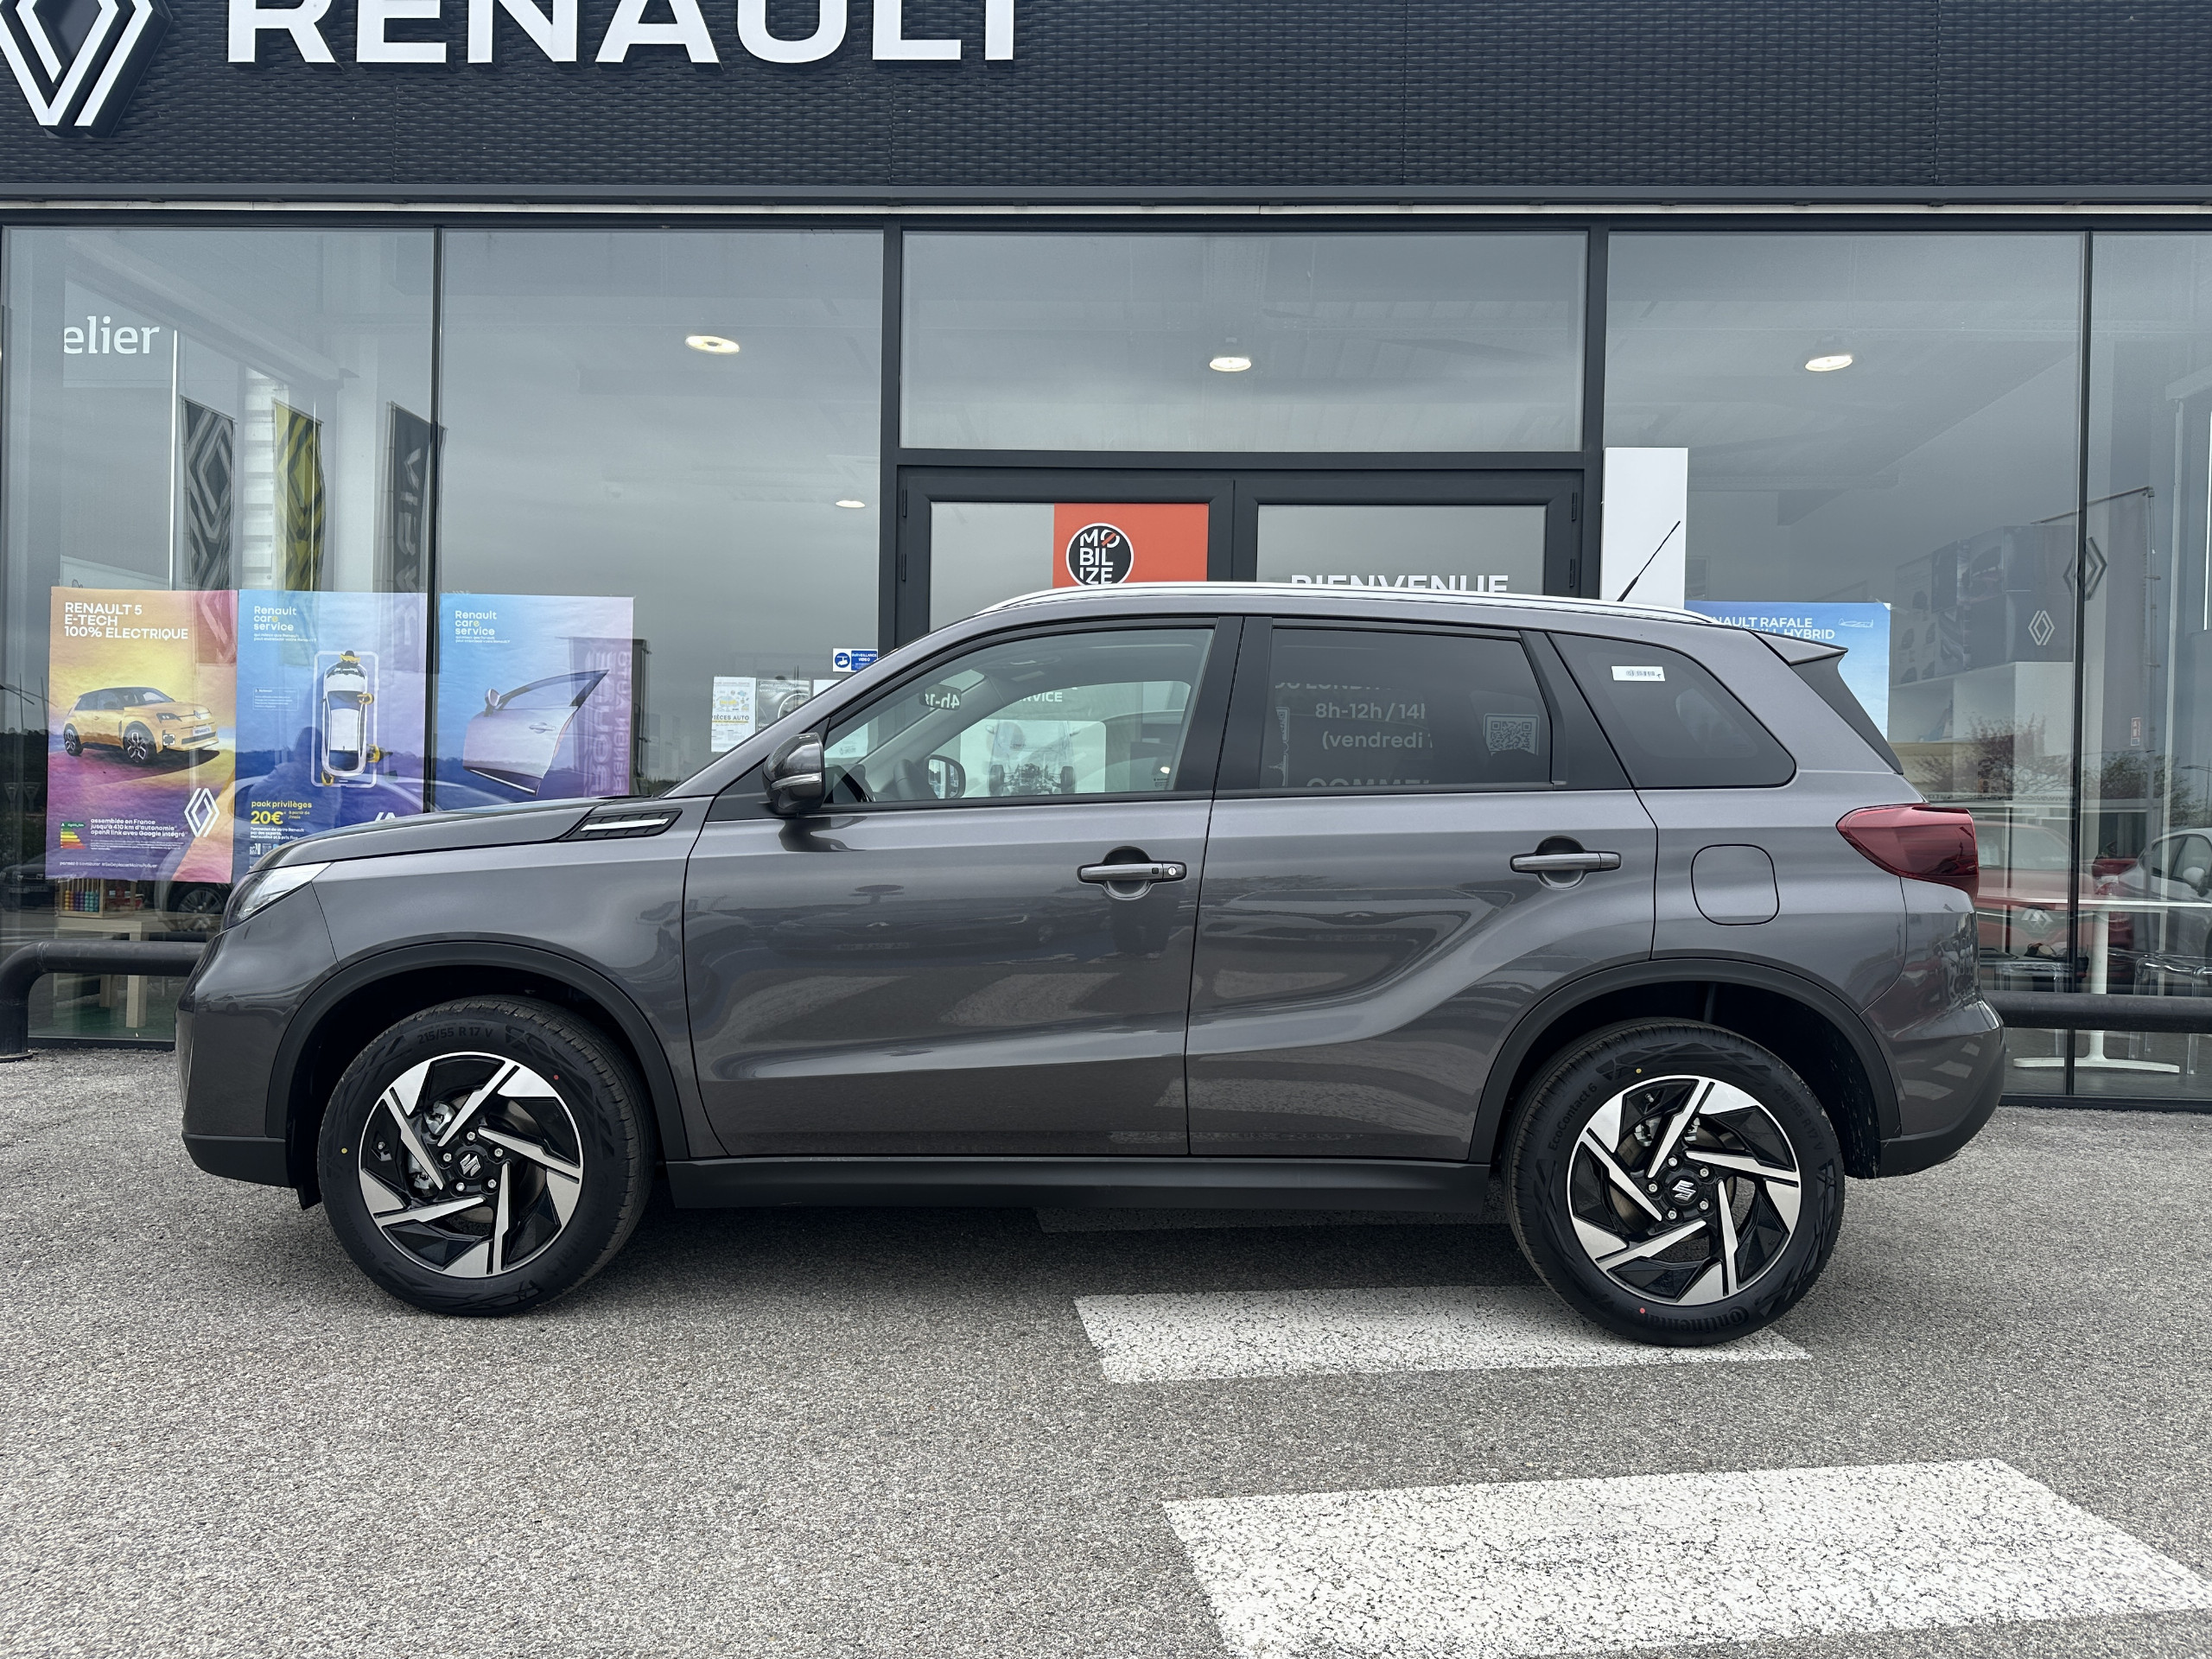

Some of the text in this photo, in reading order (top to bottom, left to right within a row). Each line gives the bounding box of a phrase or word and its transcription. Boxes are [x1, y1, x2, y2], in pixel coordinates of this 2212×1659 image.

[1080, 548, 1113, 565] BIL
[1080, 567, 1113, 584] IZE
[65, 602, 143, 615] RENAULT 5
[254, 606, 297, 615] Renault
[455, 610, 498, 620] Renault
[65, 614, 118, 626] E-TECH
[254, 622, 294, 631] service
[1760, 617, 1813, 628] RAFALE
[64, 626, 188, 640] 100% ELECTRIQUE
[455, 626, 495, 635] service
[1322, 731, 1423, 751] (vendredi
[251, 800, 312, 810] pack privilèges
[251, 810, 283, 824] 20€
[417, 1027, 454, 1045] 215/55
[459, 1026, 467, 1037] R
[469, 1027, 480, 1036] 17
[485, 1028, 493, 1037] V
[1548, 1083, 1598, 1151] EcoContact 6
